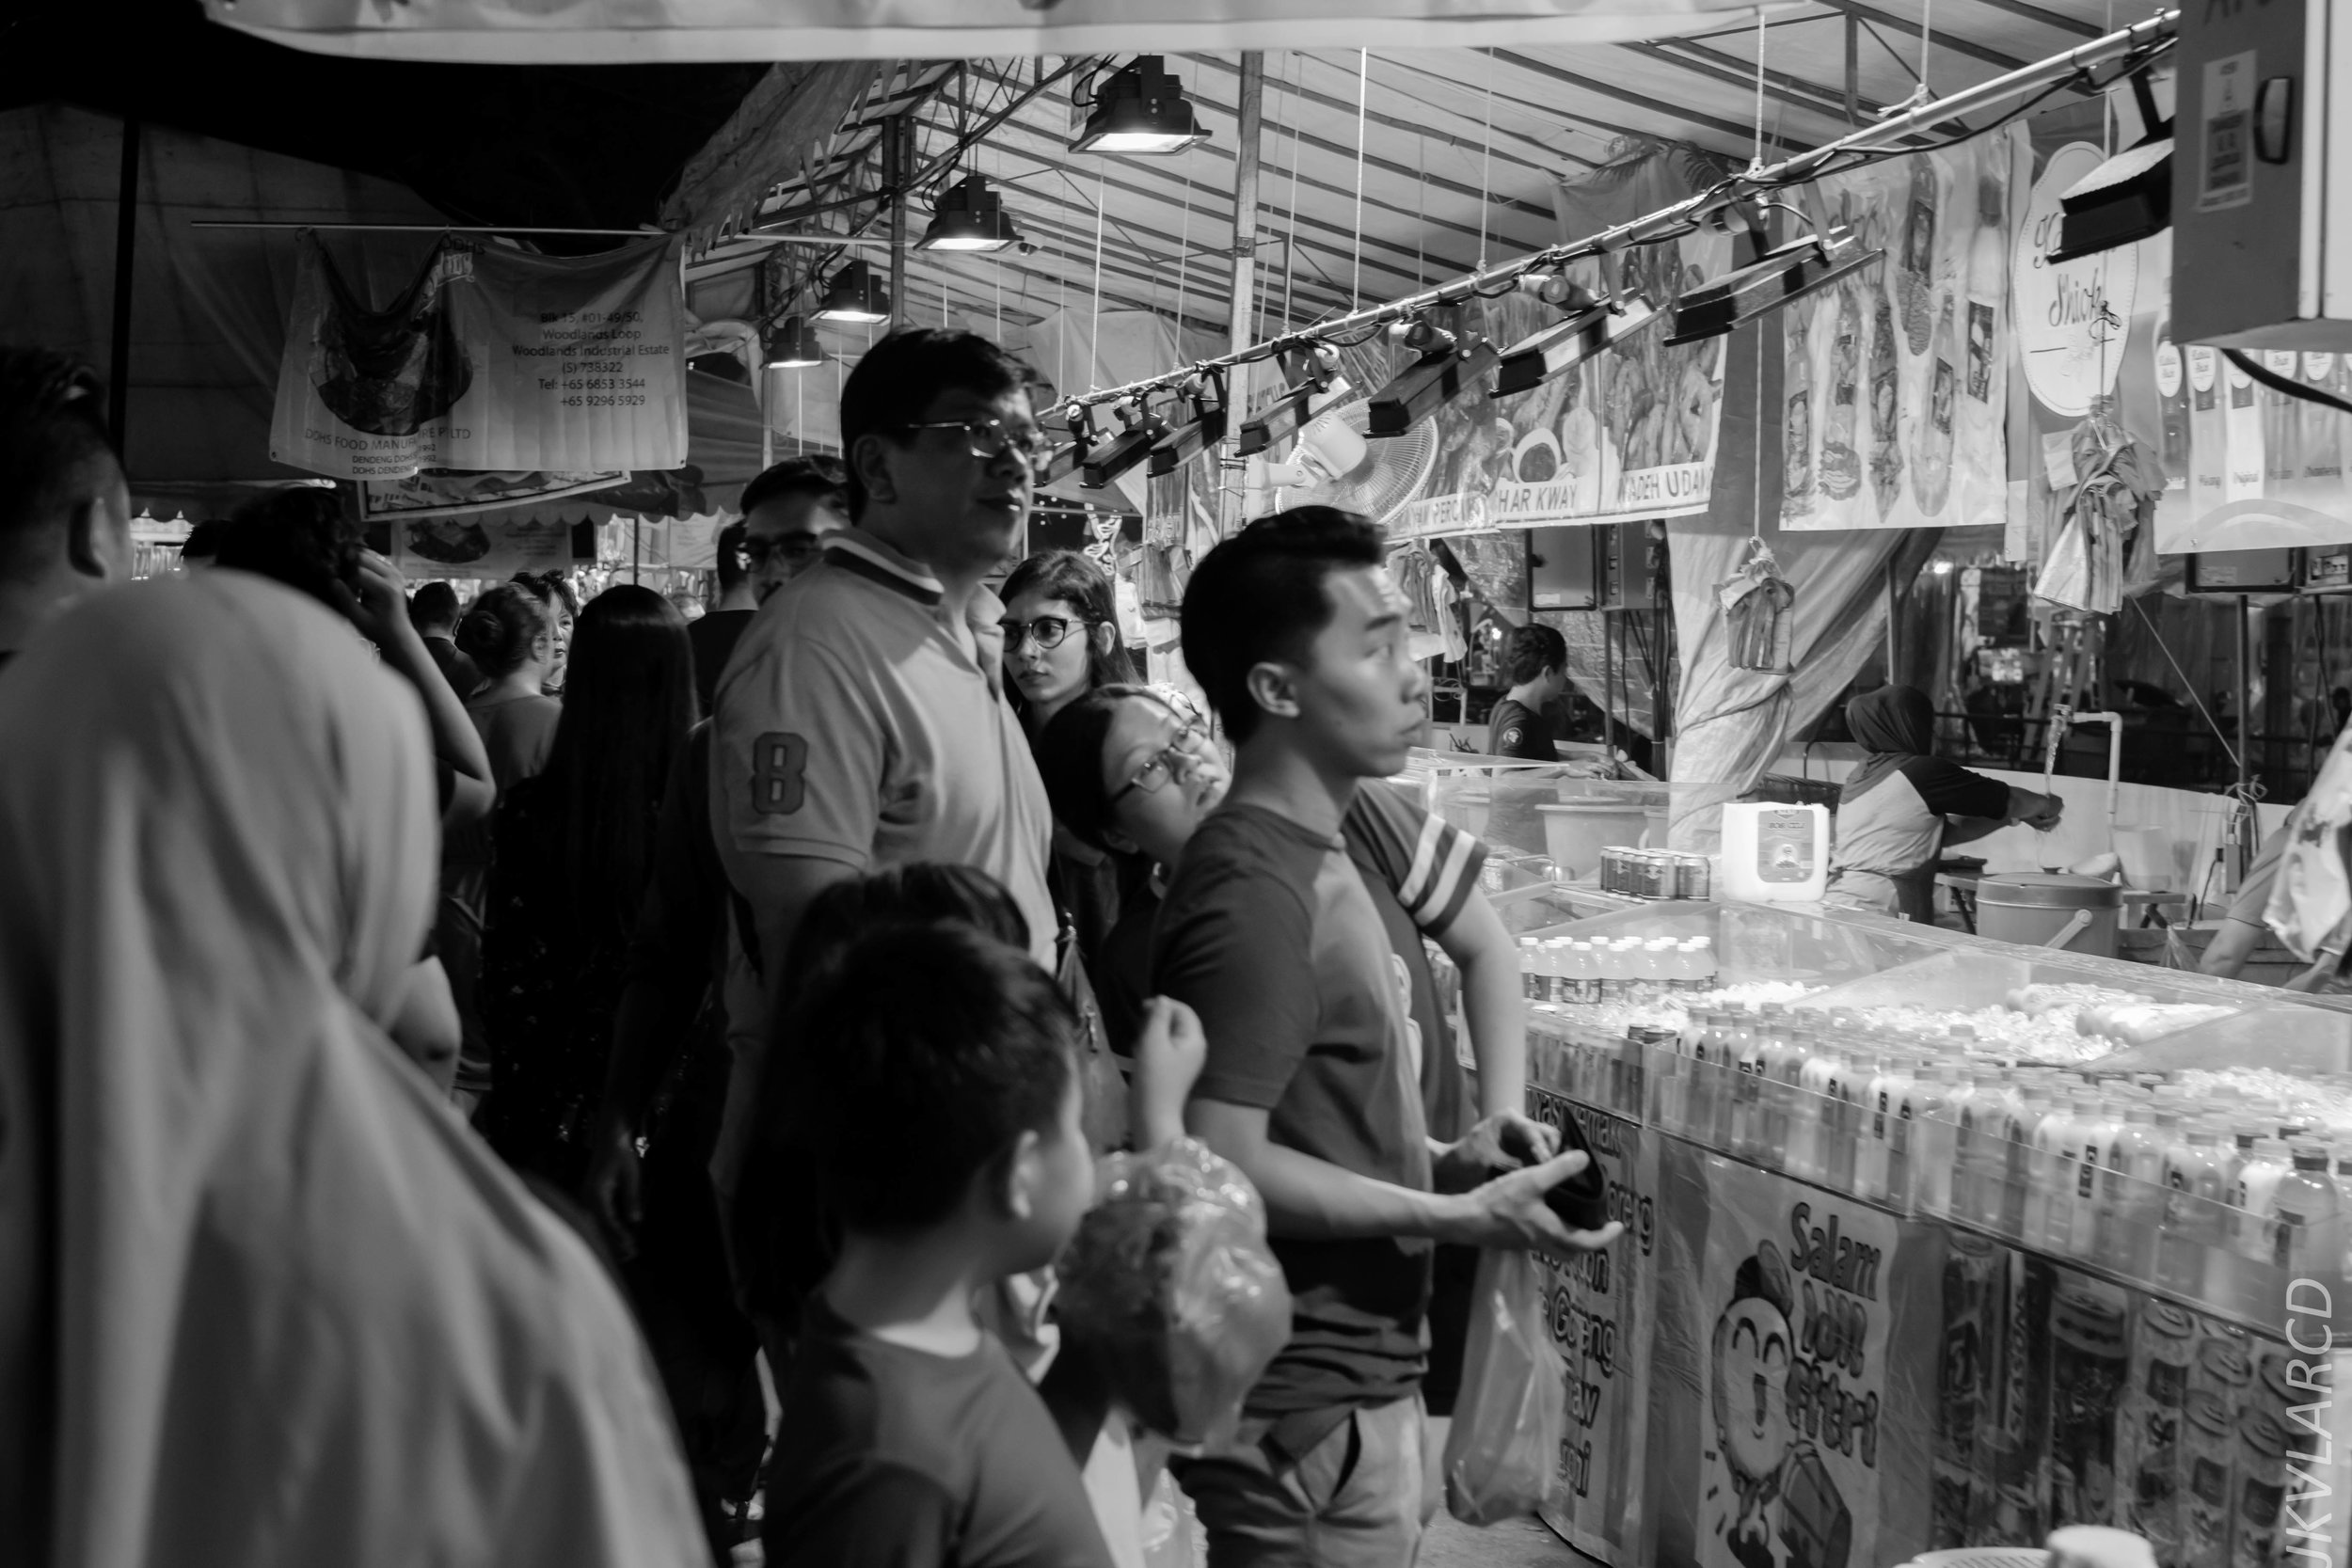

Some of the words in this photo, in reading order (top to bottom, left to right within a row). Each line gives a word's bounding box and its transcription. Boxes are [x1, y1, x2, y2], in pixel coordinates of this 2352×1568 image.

[539, 312, 558, 323] Blk
[543, 328, 609, 340] Woodlands
[611, 329, 642, 341] Loop
[512, 344, 577, 356] Woodlands
[580, 344, 635, 356] Industrial
[638, 344, 670, 356] Estate
[562, 361, 578, 374] (S)
[580, 361, 624, 373] 738322
[537, 378, 559, 390] Tel:
[561, 378, 583, 389] +65
[586, 378, 615, 390] 6853
[618, 378, 646, 389] 3544
[560, 395, 583, 406] +65
[586, 395, 615, 406] 9296
[617, 395, 646, 406] 5929
[334, 436, 369, 451] FOOD
[451, 427, 471, 440] LTD
[1494, 487, 1532, 514] HAR
[1536, 484, 1577, 511] KWAY
[752, 731, 808, 816] 8
[1790, 1201, 1881, 1302] Salam
